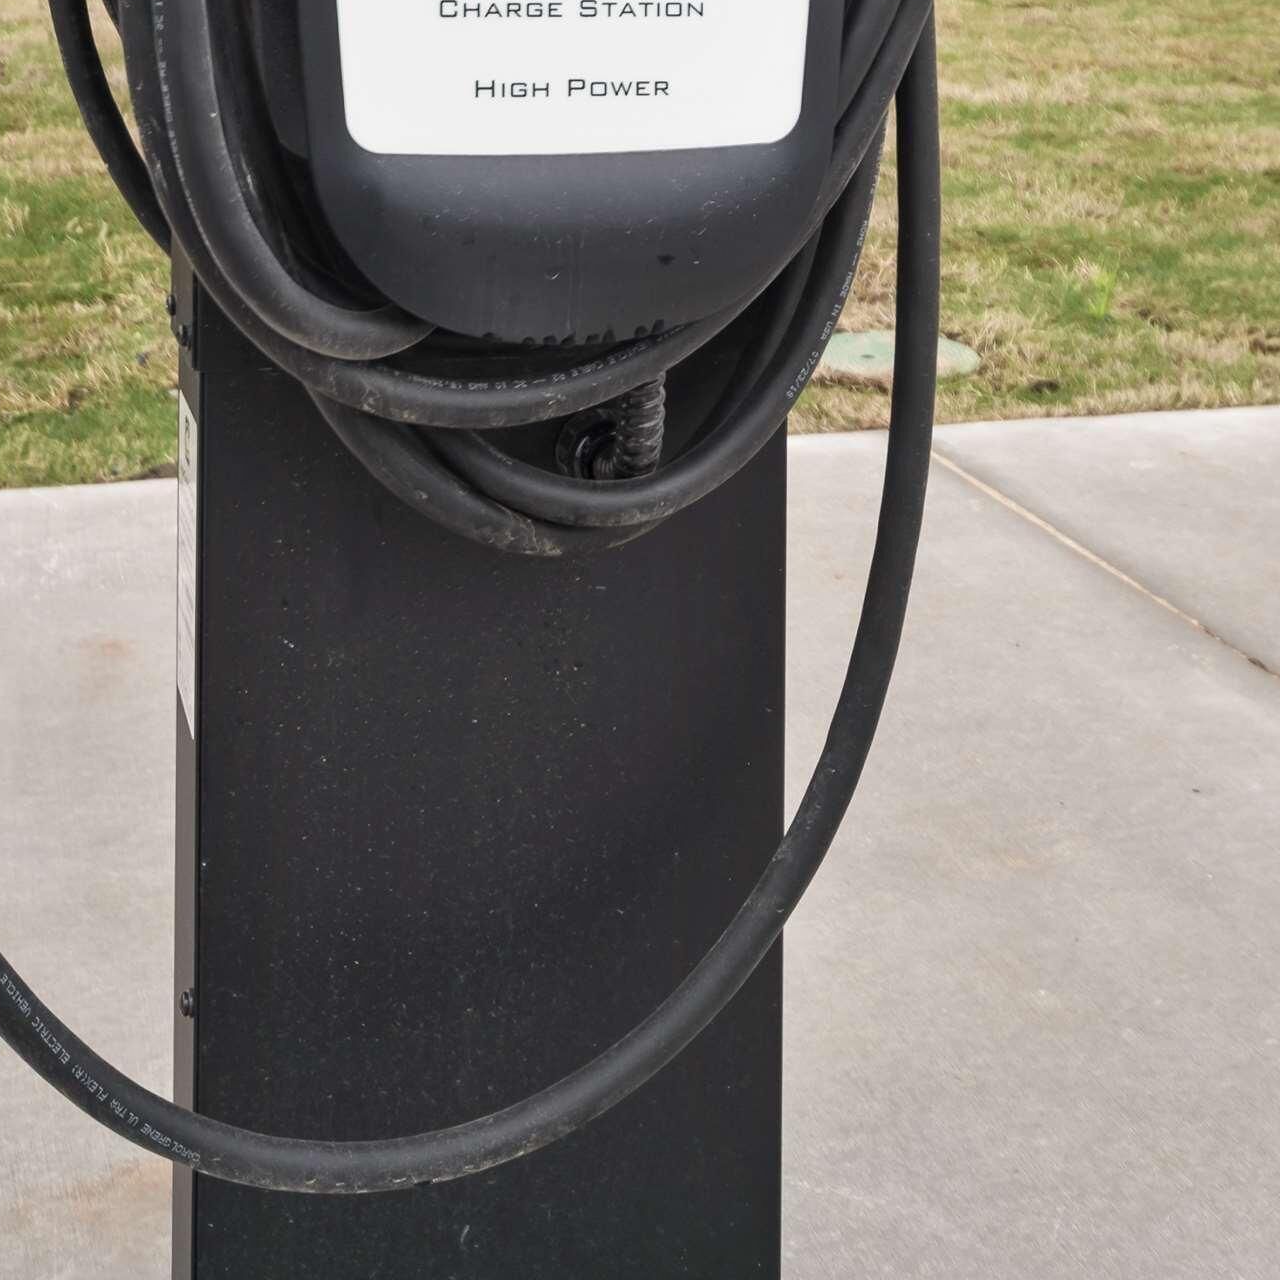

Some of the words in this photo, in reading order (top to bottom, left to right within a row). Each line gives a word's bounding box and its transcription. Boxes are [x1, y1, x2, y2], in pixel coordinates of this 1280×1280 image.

[440, 0, 562, 18] CHARGE
[580, 0, 703, 17] STATION
[475, 80, 549, 98] HIGH
[568, 79, 669, 96] POWER
[0, 973, 32, 1018] VEHICLE
[31, 1015, 71, 1065] ELECTRIC
